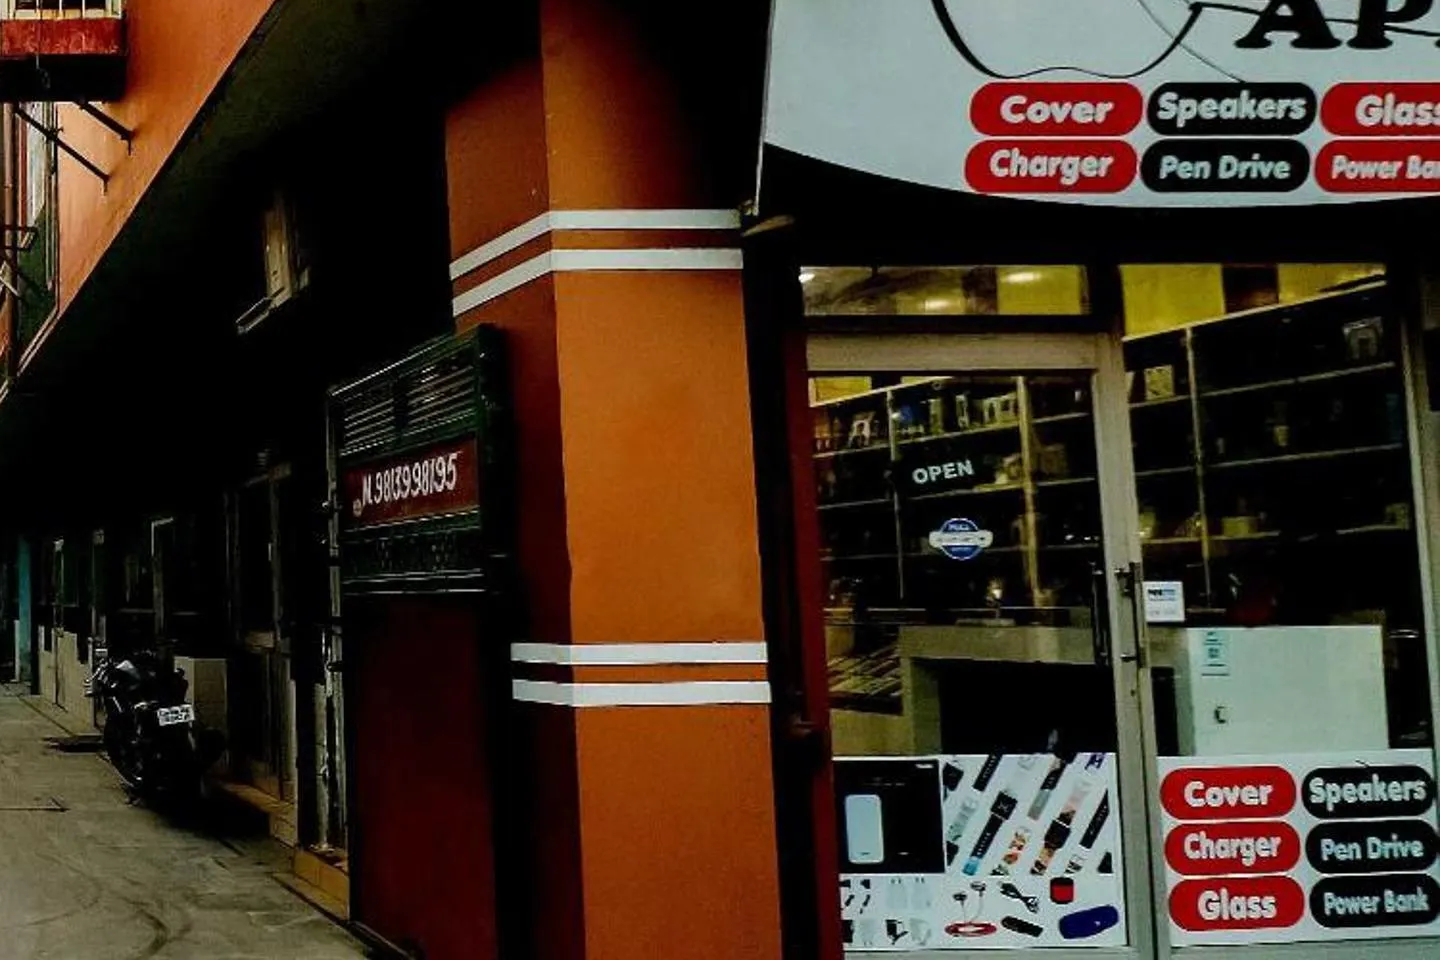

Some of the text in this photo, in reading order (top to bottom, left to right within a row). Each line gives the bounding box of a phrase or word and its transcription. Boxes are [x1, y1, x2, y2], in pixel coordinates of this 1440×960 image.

[1000, 95, 1114, 123] Cover
[1157, 90, 1307, 128] Speakers
[990, 147, 1113, 185] Charger
[1160, 153, 1291, 179] Pen Drive
[1331, 155, 1402, 179] Power
[912, 460, 975, 484] OPEN
[1184, 781, 1273, 807] Cover
[1310, 773, 1427, 812] Speakers
[1184, 831, 1282, 866] Charger
[1320, 834, 1424, 861] Pen Drive
[1197, 888, 1277, 921] Glass
[1324, 887, 1429, 916] Power Bank
